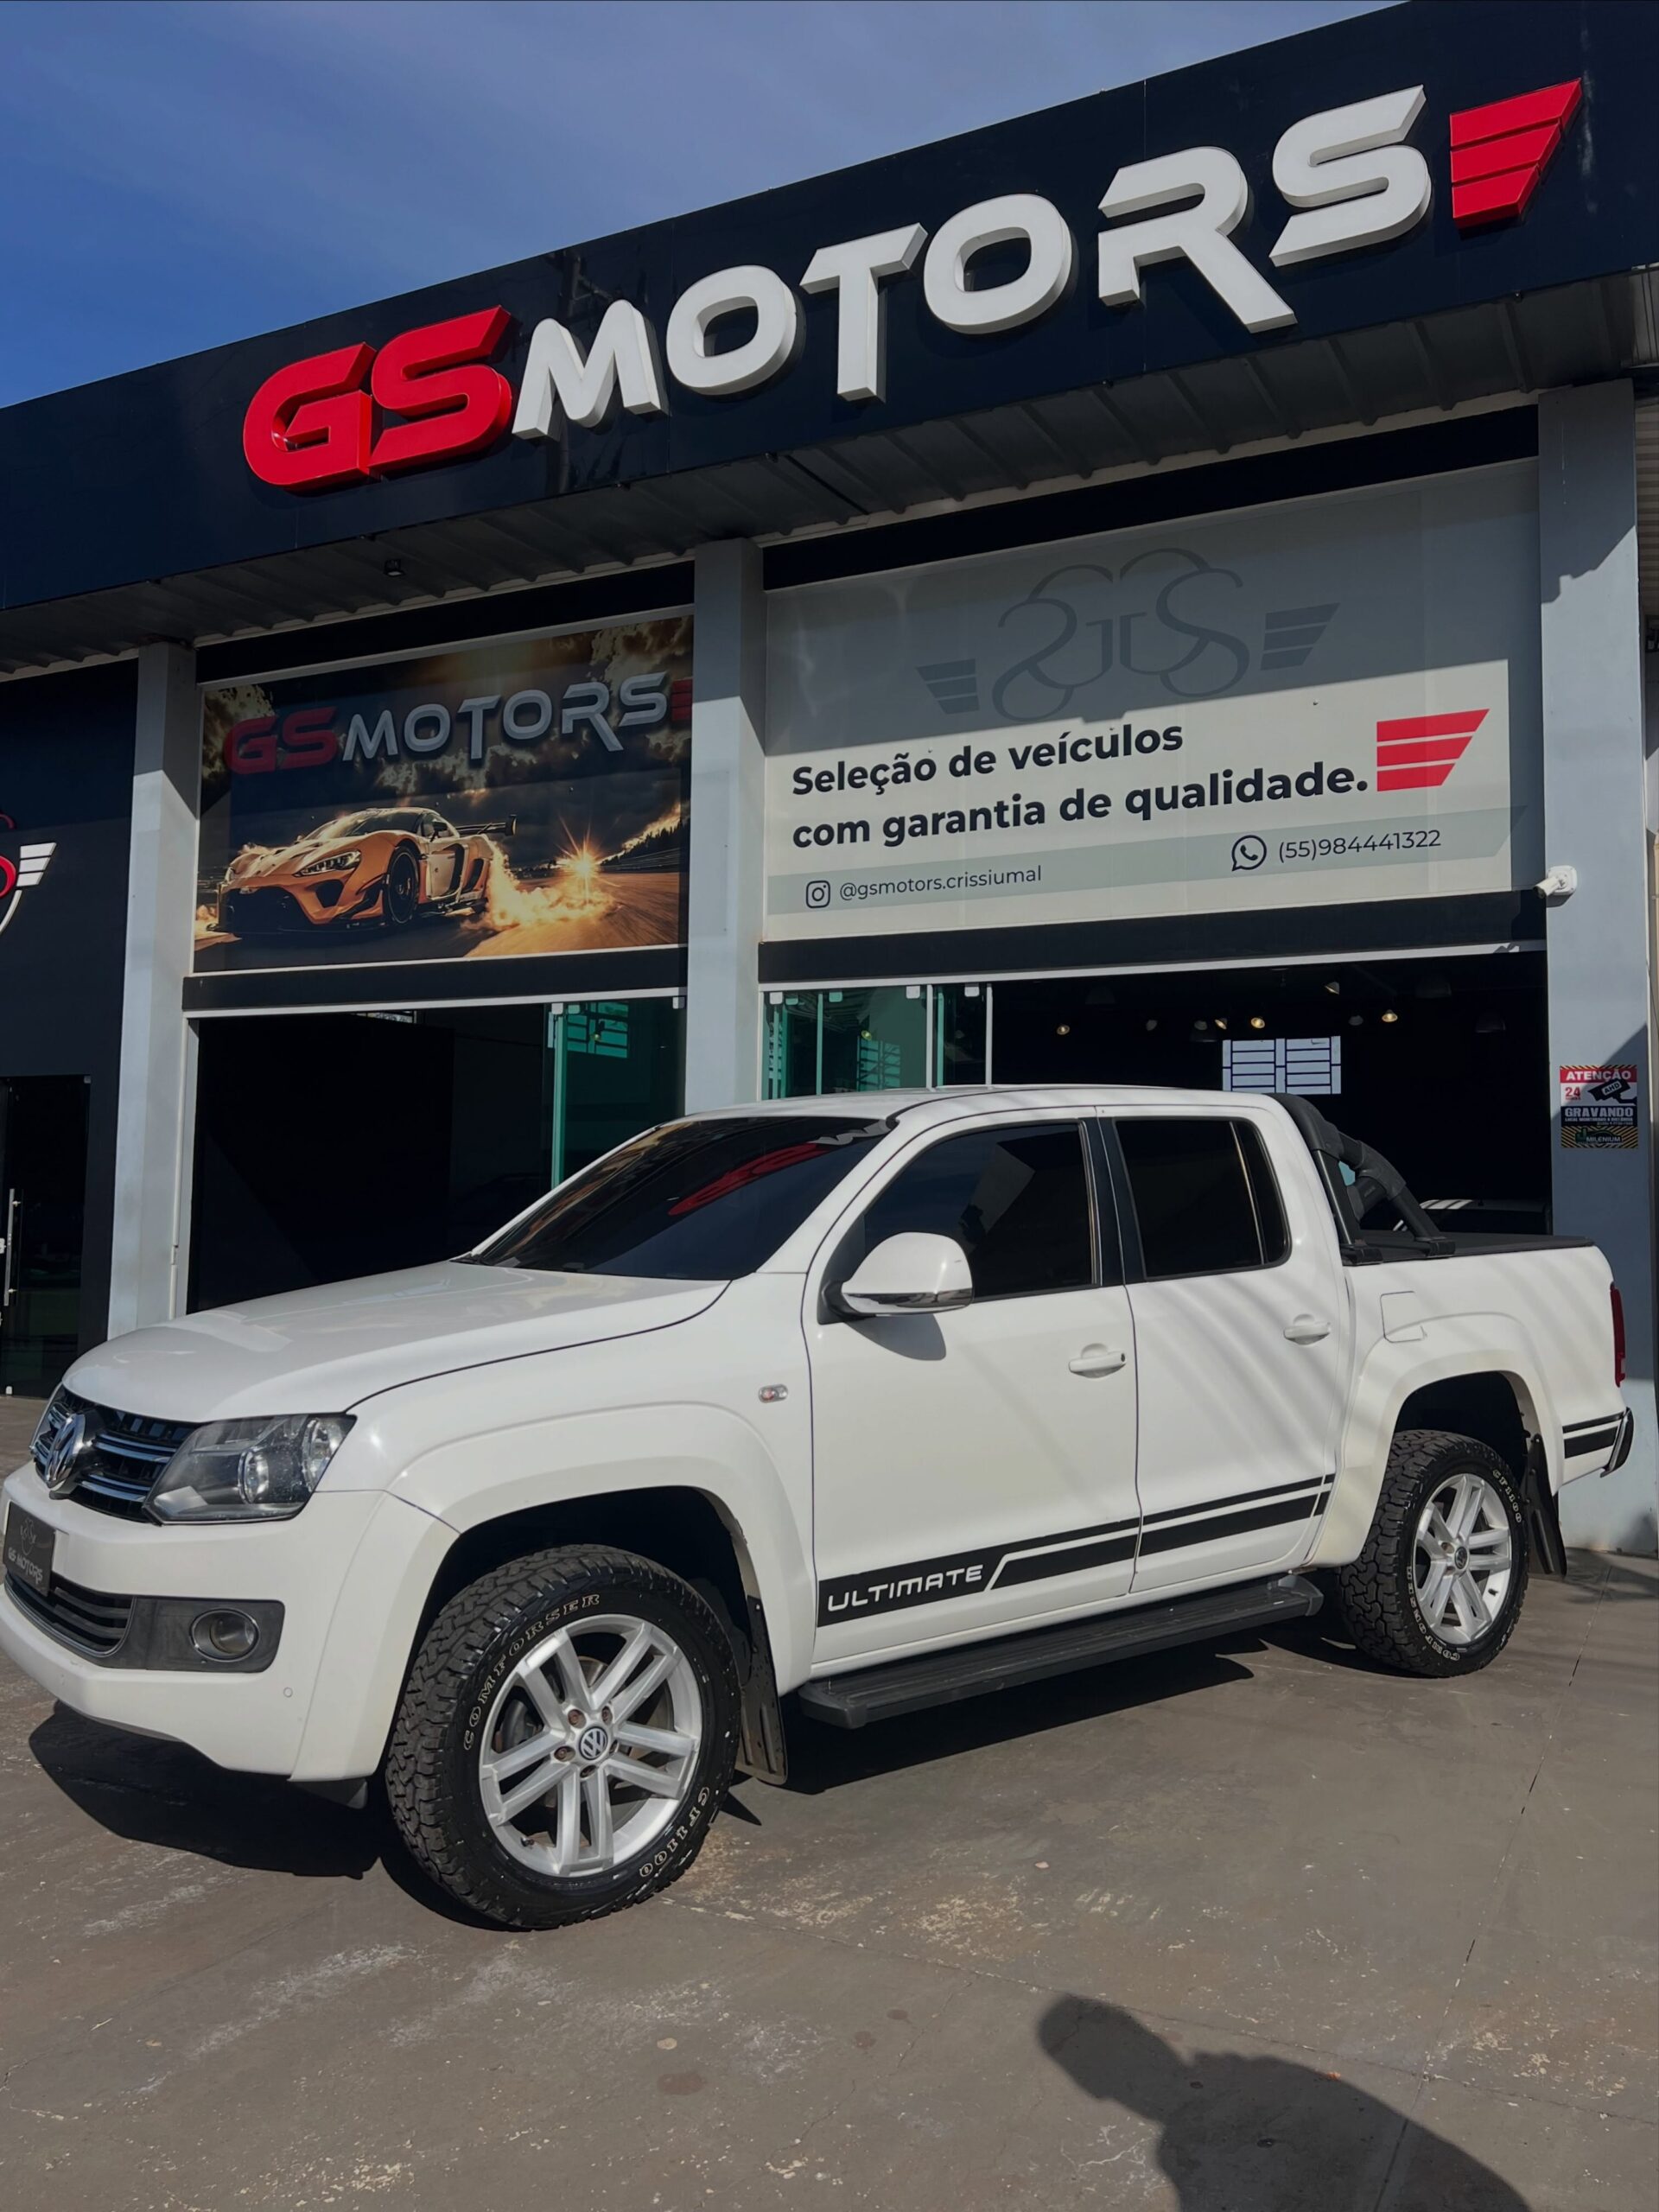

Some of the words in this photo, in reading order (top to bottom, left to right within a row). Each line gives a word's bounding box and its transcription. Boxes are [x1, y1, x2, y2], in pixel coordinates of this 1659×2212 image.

[792, 752, 937, 796] Seleção
[949, 745, 996, 778] de
[1007, 723, 1184, 770] veículos
[792, 819, 871, 849] com
[882, 793, 1046, 848] garantia
[1059, 787, 1112, 821] de
[1125, 761, 1369, 821] qualidade.
[1278, 829, 1442, 863] (55)984441322
[839, 865, 1042, 901] @gsmotors.crissiumal
[1565, 1087, 1580, 1096] 24
[1566, 1069, 1631, 1082] ATENÇÃO
[1564, 1107, 1634, 1117] GRAVANDO
[827, 1564, 983, 1612] ULTIMATE
[463, 1593, 601, 1751] COMFORSER
